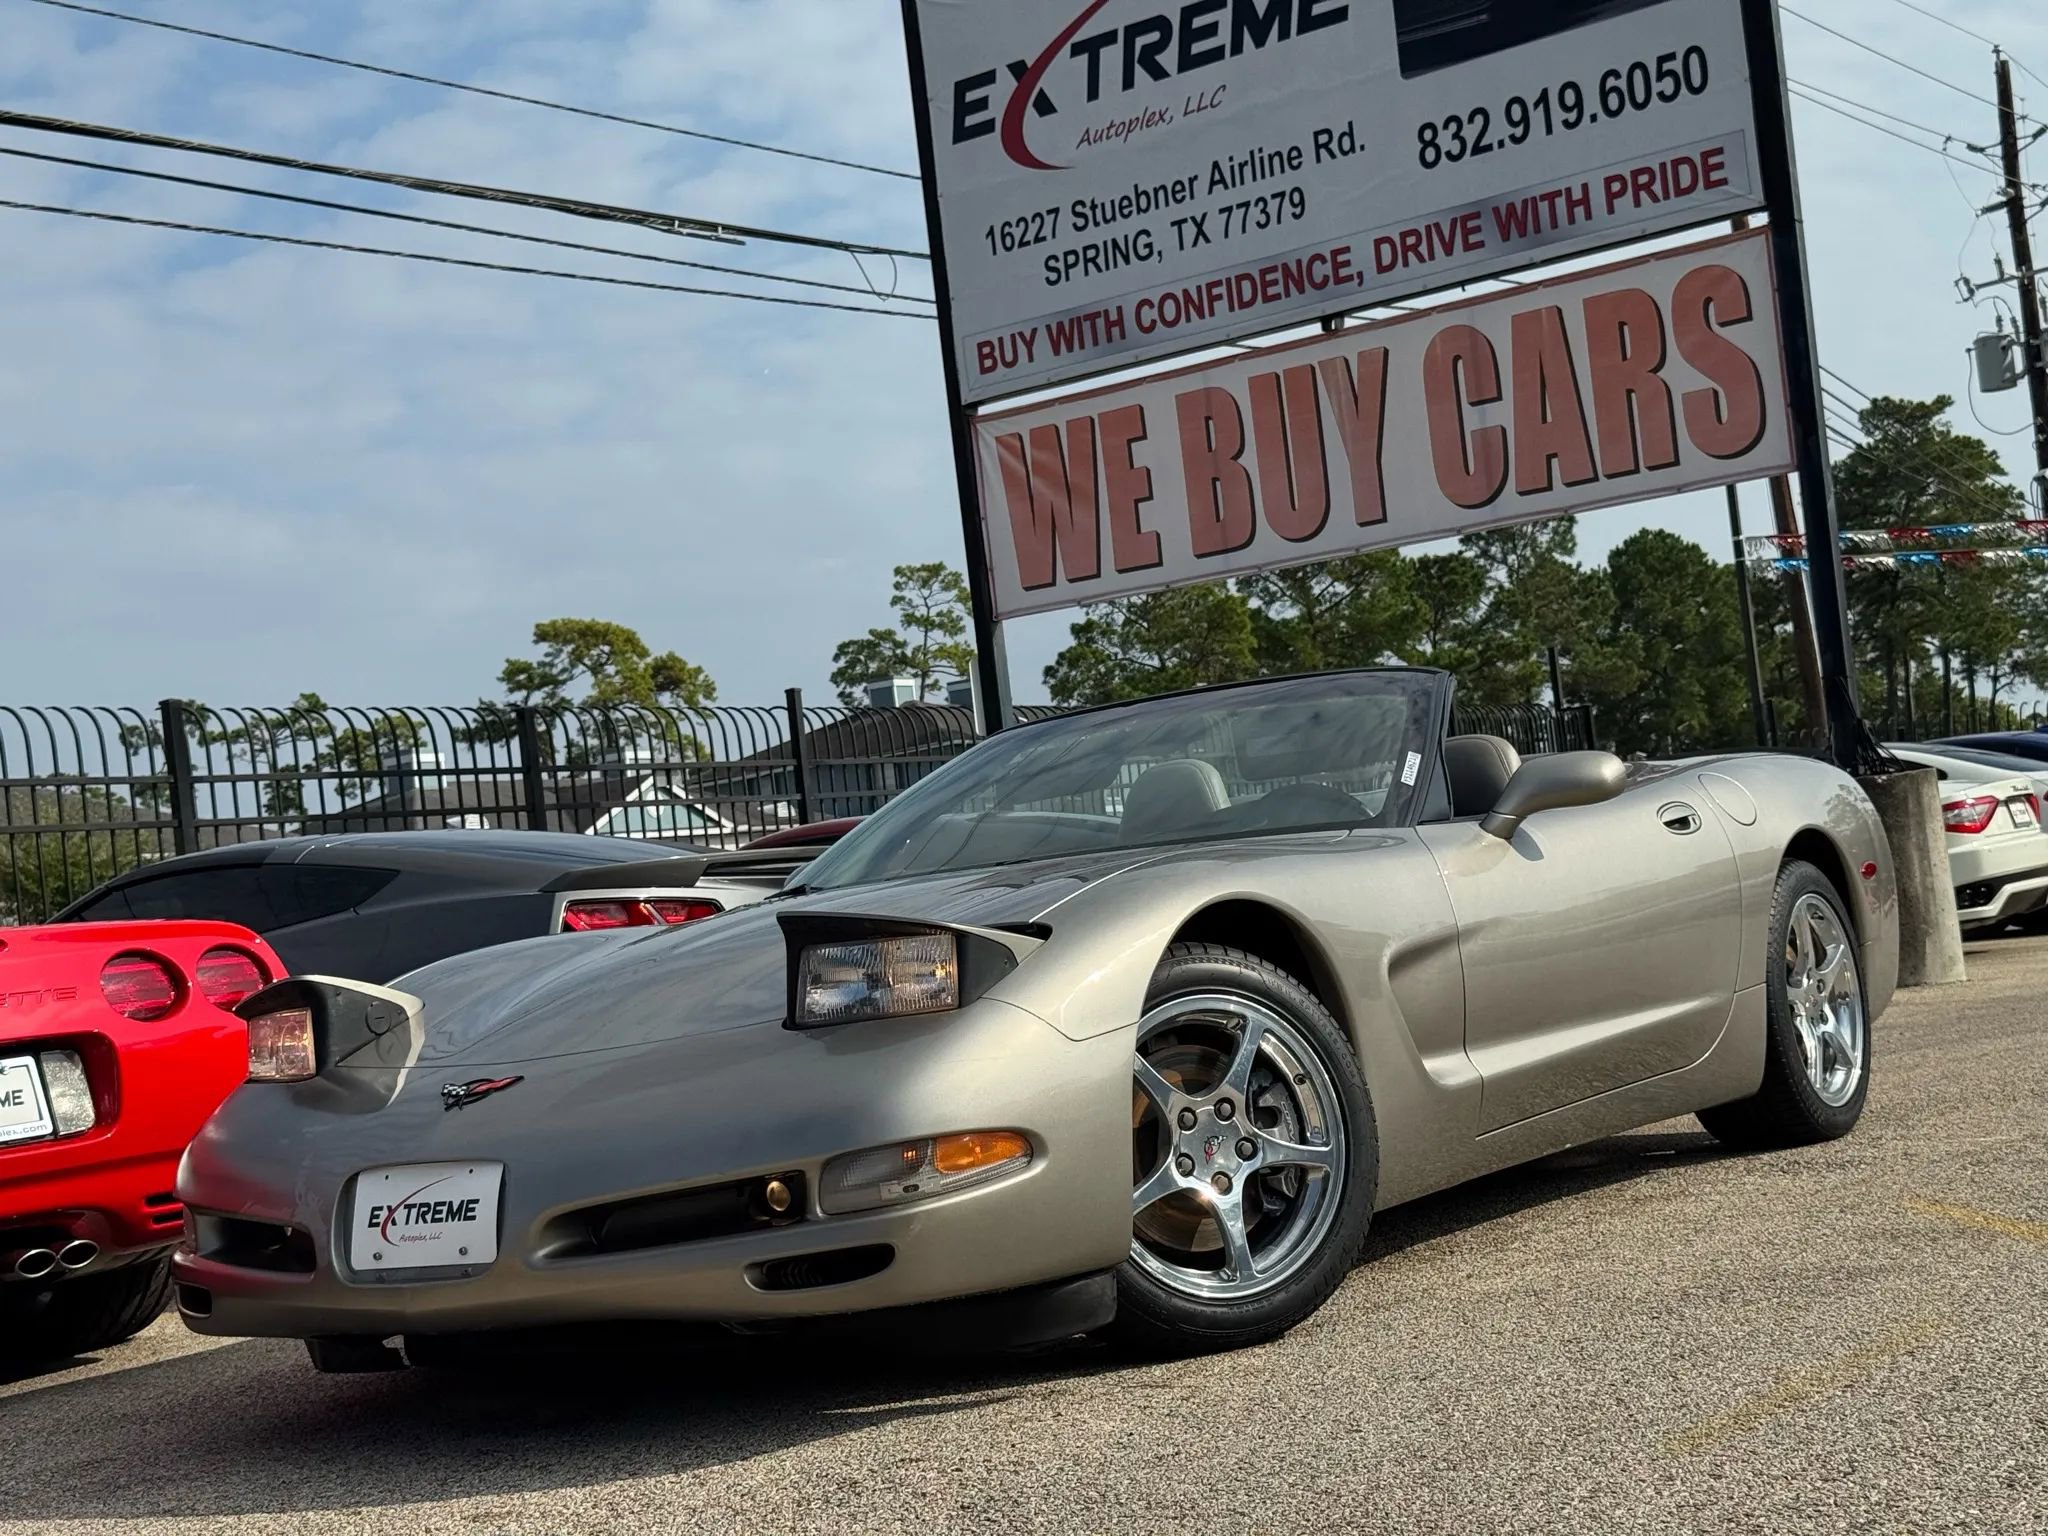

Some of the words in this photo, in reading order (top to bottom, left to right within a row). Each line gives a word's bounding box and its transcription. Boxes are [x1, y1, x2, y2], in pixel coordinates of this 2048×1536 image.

[952, 0, 1349, 145] EXTREME
[1076, 105, 1174, 150] Autoplex,
[1182, 85, 1226, 118] LLC
[1417, 45, 1709, 170] 832.919.6050
[985, 207, 1061, 256] 16227
[1071, 174, 1199, 233] Stuebner
[1207, 145, 1303, 195] Airline
[1312, 121, 1366, 164] Rd.
[1044, 230, 1163, 286] SPRING,
[1170, 212, 1212, 251] TX
[1217, 187, 1306, 239] 77379
[976, 328, 1039, 375] BUY
[1045, 305, 1126, 356] WITH
[1134, 246, 1364, 334] CONFIDENCE,
[1373, 211, 1485, 275] DRIVE
[1491, 182, 1592, 242] WITH
[1603, 147, 1729, 215] PRIDE
[995, 404, 1161, 590] WE
[1176, 346, 1389, 559] BUY
[1423, 264, 1766, 509] CARS
[0, 986, 79, 1007] TTE
[0, 1124, 48, 1137] lex.com
[367, 1198, 481, 1228] EXTREME
